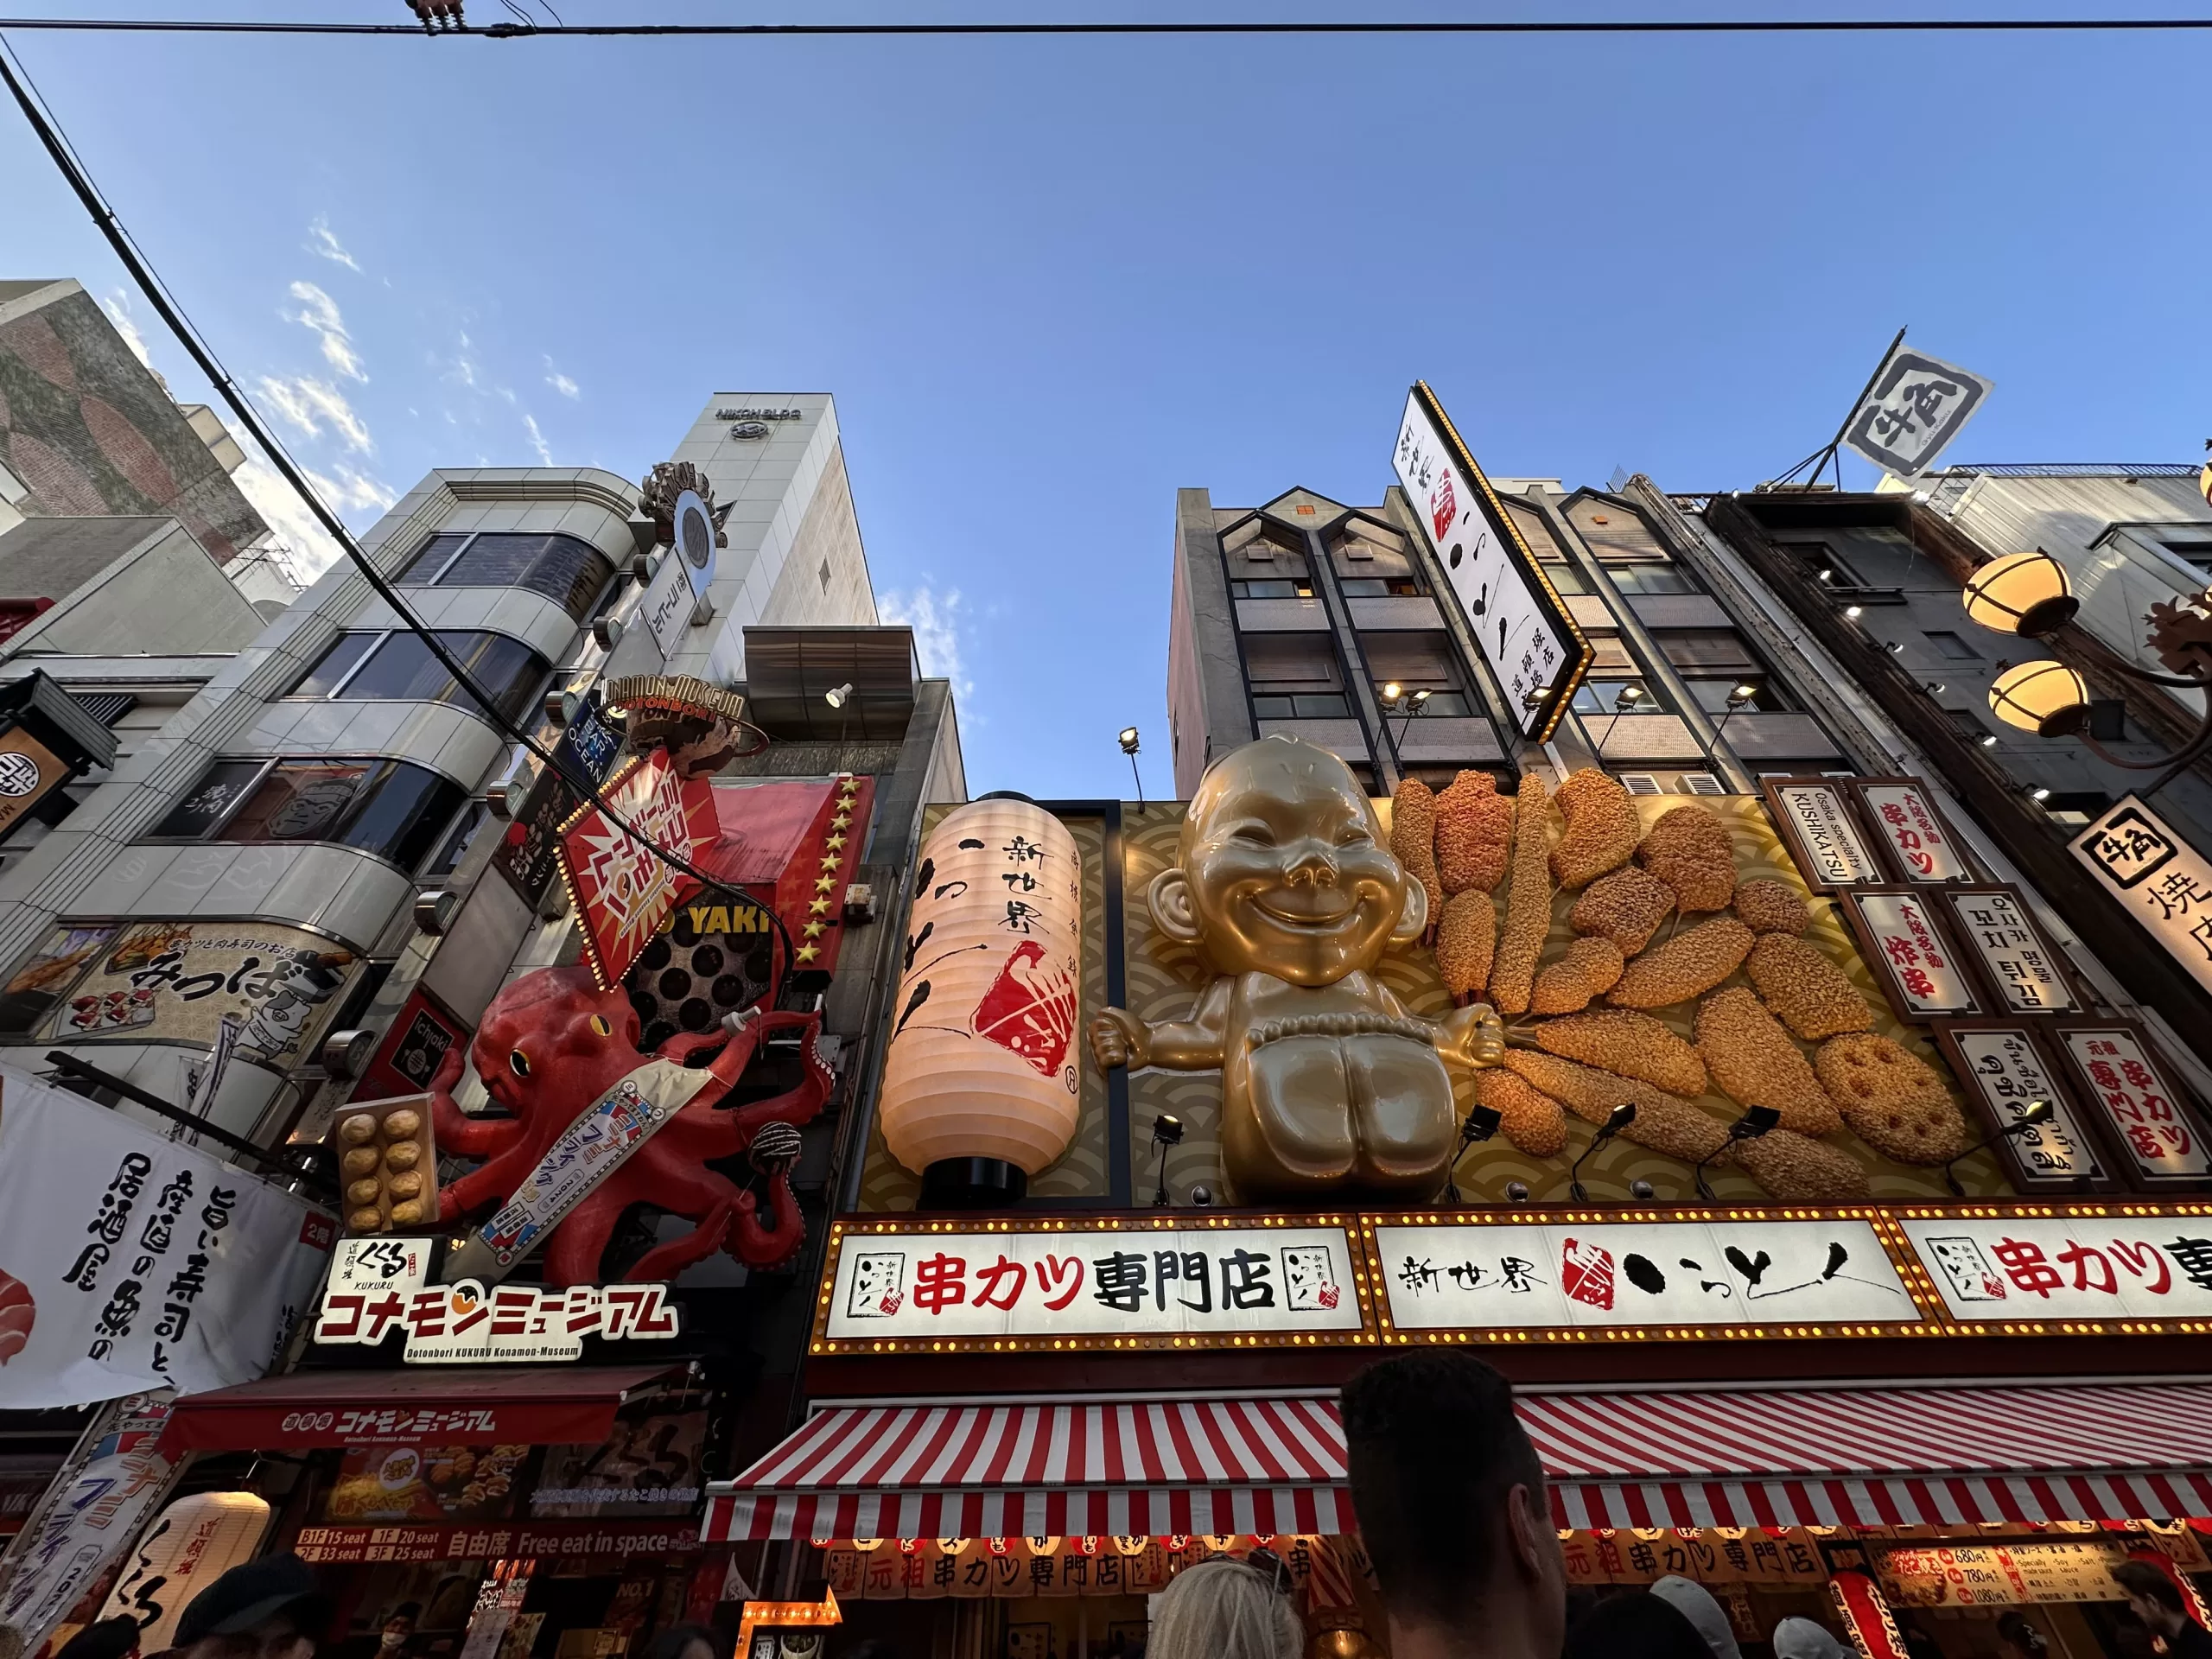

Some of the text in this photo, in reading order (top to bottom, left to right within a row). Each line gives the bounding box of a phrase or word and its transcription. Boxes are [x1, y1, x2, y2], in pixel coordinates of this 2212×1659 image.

[1875, 380, 1957, 448] 牛角
[1400, 414, 1433, 499] 新世界
[601, 674, 746, 718] KONAMON MUSEUM
[568, 727, 603, 784] OCEAN
[584, 719, 605, 756] BAR
[1815, 792, 1861, 870] Osaka specialty
[1878, 802, 1933, 875] 串カツ
[2102, 829, 2160, 863] 牛角
[998, 835, 1055, 935] 新世界
[688, 906, 769, 934] YAKI
[1992, 898, 2052, 984] 오사카 명물
[130, 949, 304, 1001] みつば
[1997, 960, 2043, 1007] 튀김
[2123, 1058, 2190, 1155] 串カツ
[550, 1179, 574, 1204] 2024
[62, 1152, 151, 1292] 居酒屋
[87, 1170, 194, 1363] 産直の魚の
[356, 1242, 407, 1279] くくる
[912, 1248, 1277, 1315] 串カツ専門店
[1398, 1255, 1548, 1298] 新世界
[354, 1281, 394, 1290] KUKURU
[320, 1284, 674, 1338] コナモンミュージアム
[407, 1345, 579, 1359] Dotonbori KUKURU Konamon-Museum
[282, 1411, 334, 1432] 道頓堀
[334, 1407, 496, 1434] コナモンミュージアム
[302, 1529, 439, 1545] B1F 15 seat 1F 20 seat
[321, 1548, 336, 1560] 33
[338, 1548, 361, 1560] seat
[372, 1547, 388, 1559] 3F
[394, 1548, 410, 1560] 25
[410, 1548, 435, 1560] seat
[447, 1530, 512, 1557] 自由席
[518, 1532, 559, 1554] Free
[562, 1533, 594, 1554] eat
[594, 1530, 613, 1553] in
[615, 1534, 668, 1558] space
[616, 1580, 655, 1598] NO.1
